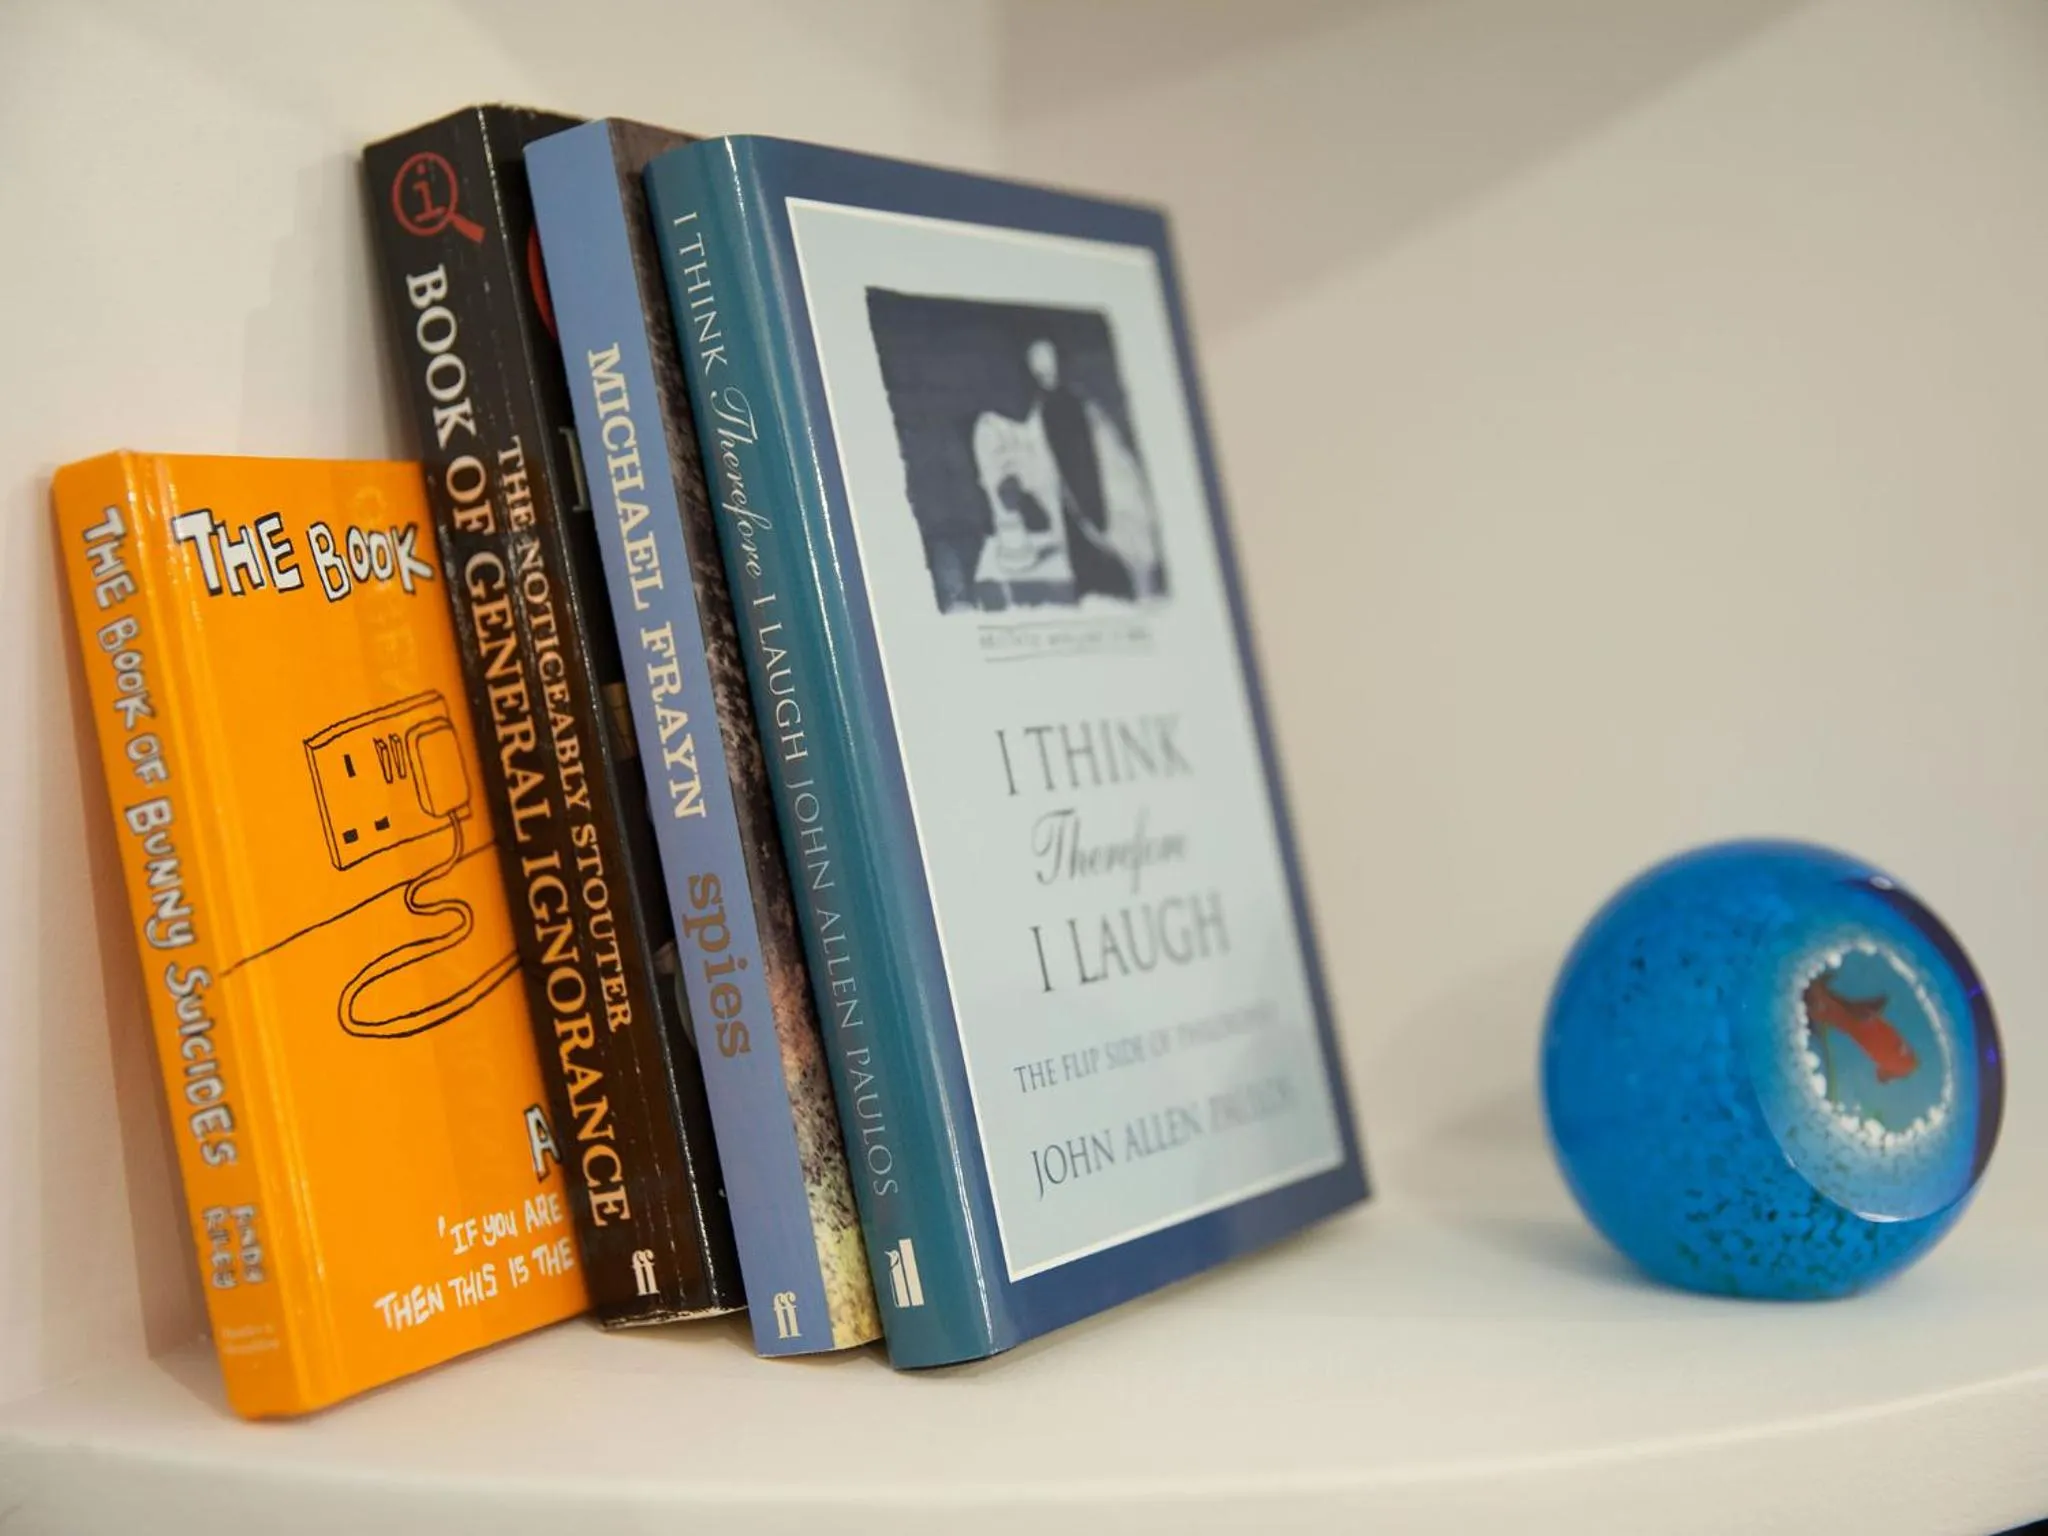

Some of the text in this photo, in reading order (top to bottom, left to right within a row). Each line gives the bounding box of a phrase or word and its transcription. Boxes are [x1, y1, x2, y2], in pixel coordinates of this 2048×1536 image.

[82, 506, 140, 610] THE
[171, 508, 435, 603] THE BOOK
[588, 343, 708, 820] MICHAEL FRAYN
[95, 616, 156, 729] BOOK
[673, 211, 900, 1198] I THINK Therefore I LAUGH JOHN ALLEN PAULOS
[126, 733, 169, 788] OF
[405, 264, 631, 1228] BOOK OF GENERAL IGNORANCE
[497, 434, 633, 1033] THE NOTICEABLY STOUTER
[1024, 712, 1194, 791] THINK
[683, 872, 752, 1059] spies
[1066, 889, 1231, 985] LAUGH
[1013, 1057, 1058, 1094] THE
[1061, 1045, 1102, 1082] FLIP
[1030, 1129, 1117, 1201] JOHN
[1124, 1101, 1204, 1163] ALLEN
[482, 1208, 519, 1247] YOU
[524, 1192, 564, 1234] ARE
[373, 1235, 575, 1332] THEN THIS IS THE
